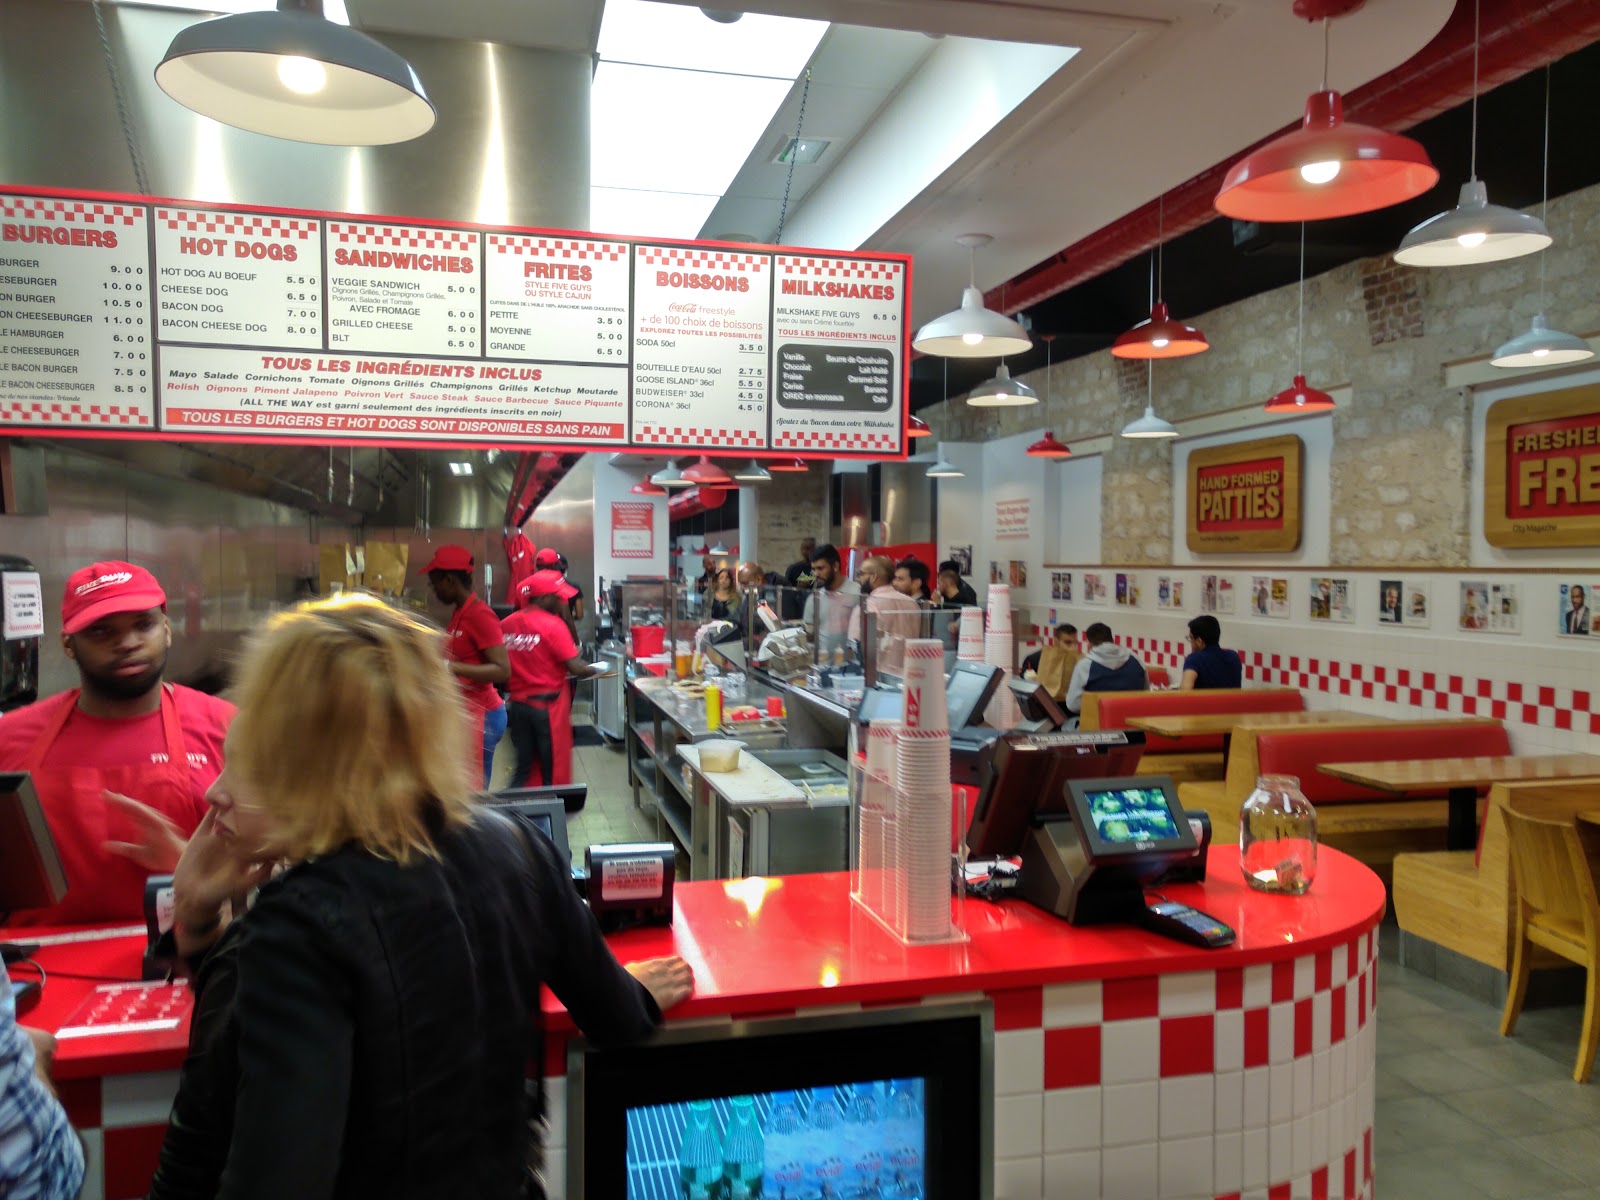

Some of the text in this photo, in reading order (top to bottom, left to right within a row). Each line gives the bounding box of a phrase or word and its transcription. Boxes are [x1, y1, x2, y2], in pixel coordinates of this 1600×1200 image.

[2, 224, 117, 248] BURGERS
[180, 237, 297, 261] HOT DOGS
[335, 248, 473, 273] SANDWICHES
[161, 268, 181, 276] HOT
[184, 269, 205, 278] DOG
[209, 271, 221, 279] AU
[225, 272, 257, 281] BOEUF
[524, 261, 592, 281] FRITES
[332, 278, 367, 287] VEGGIE
[370, 280, 420, 290] SANDWICH
[525, 281, 549, 289] STYLE
[656, 271, 749, 292] BOISSONS
[162, 285, 203, 294] CHEESE
[206, 287, 228, 296] DOG
[332, 287, 424, 299] Oignons Champignons
[782, 279, 894, 300] MILKSHAKES
[16, 294, 55, 303] BURGER
[162, 302, 198, 311] BACON
[201, 304, 223, 313] DOG
[350, 305, 374, 313] AVEC
[377, 307, 420, 316] FROMAGE
[699, 305, 735, 316] freestyle
[777, 308, 820, 316] MILKSHAKE
[16, 312, 93, 322] CHEESEBURGER
[490, 311, 519, 319] PETITE
[162, 319, 198, 328] BACON
[202, 321, 242, 330] CHEESE
[245, 324, 267, 332] DOG
[333, 319, 373, 328] GRILLED
[376, 322, 413, 330] CHEESE
[650, 314, 762, 330] de 100 choix de boissons
[10, 329, 64, 339] HAMBURGER
[490, 327, 531, 335] MOYENNE
[817, 330, 867, 339] INGRÉDIENTS
[333, 334, 349, 342] BLT
[11, 346, 79, 356] CHEESEBURGER
[490, 342, 526, 351] GRANDE
[12, 364, 78, 373] BACON BURGER
[262, 357, 542, 381] TOUS LES INGRÉDIENTS INCLUS
[636, 364, 679, 372] BOUTEILLE
[9, 381, 94, 391] BACON CHEESEBURGER
[169, 370, 197, 379] Mayo
[204, 372, 239, 380] Salade
[246, 374, 302, 383] Cornichons
[310, 376, 345, 384] Tomate
[352, 378, 390, 387] Oignons
[394, 380, 424, 388] Grillés
[430, 381, 493, 392] Champignons
[534, 386, 571, 395] Ketchup
[577, 387, 618, 395] Moutarde
[167, 383, 199, 391] Relish
[206, 384, 247, 393] Oignons
[254, 386, 289, 394] Piment
[293, 388, 338, 397] Jalapeno
[344, 390, 380, 398] Poivron
[475, 395, 502, 403] Sauce
[506, 396, 548, 404] Barbecue
[554, 398, 581, 406] Sauce
[585, 399, 623, 408] Piquante
[240, 399, 263, 407] (ALL
[268, 399, 287, 407] THE
[335, 402, 360, 410] garni
[363, 403, 412, 411] seulement
[436, 406, 487, 414] ingrédients
[183, 411, 611, 435] TOUS LES BURGERS ET HOT DOGS SONT DISPONIBLES SANS PAIN
[776, 418, 798, 426] Ajoutez
[1514, 426, 1600, 453] FRESHE
[1200, 470, 1279, 490] HAND FORMED
[1200, 486, 1280, 521] PATTIES
[1513, 524, 1556, 533] City Magazine
